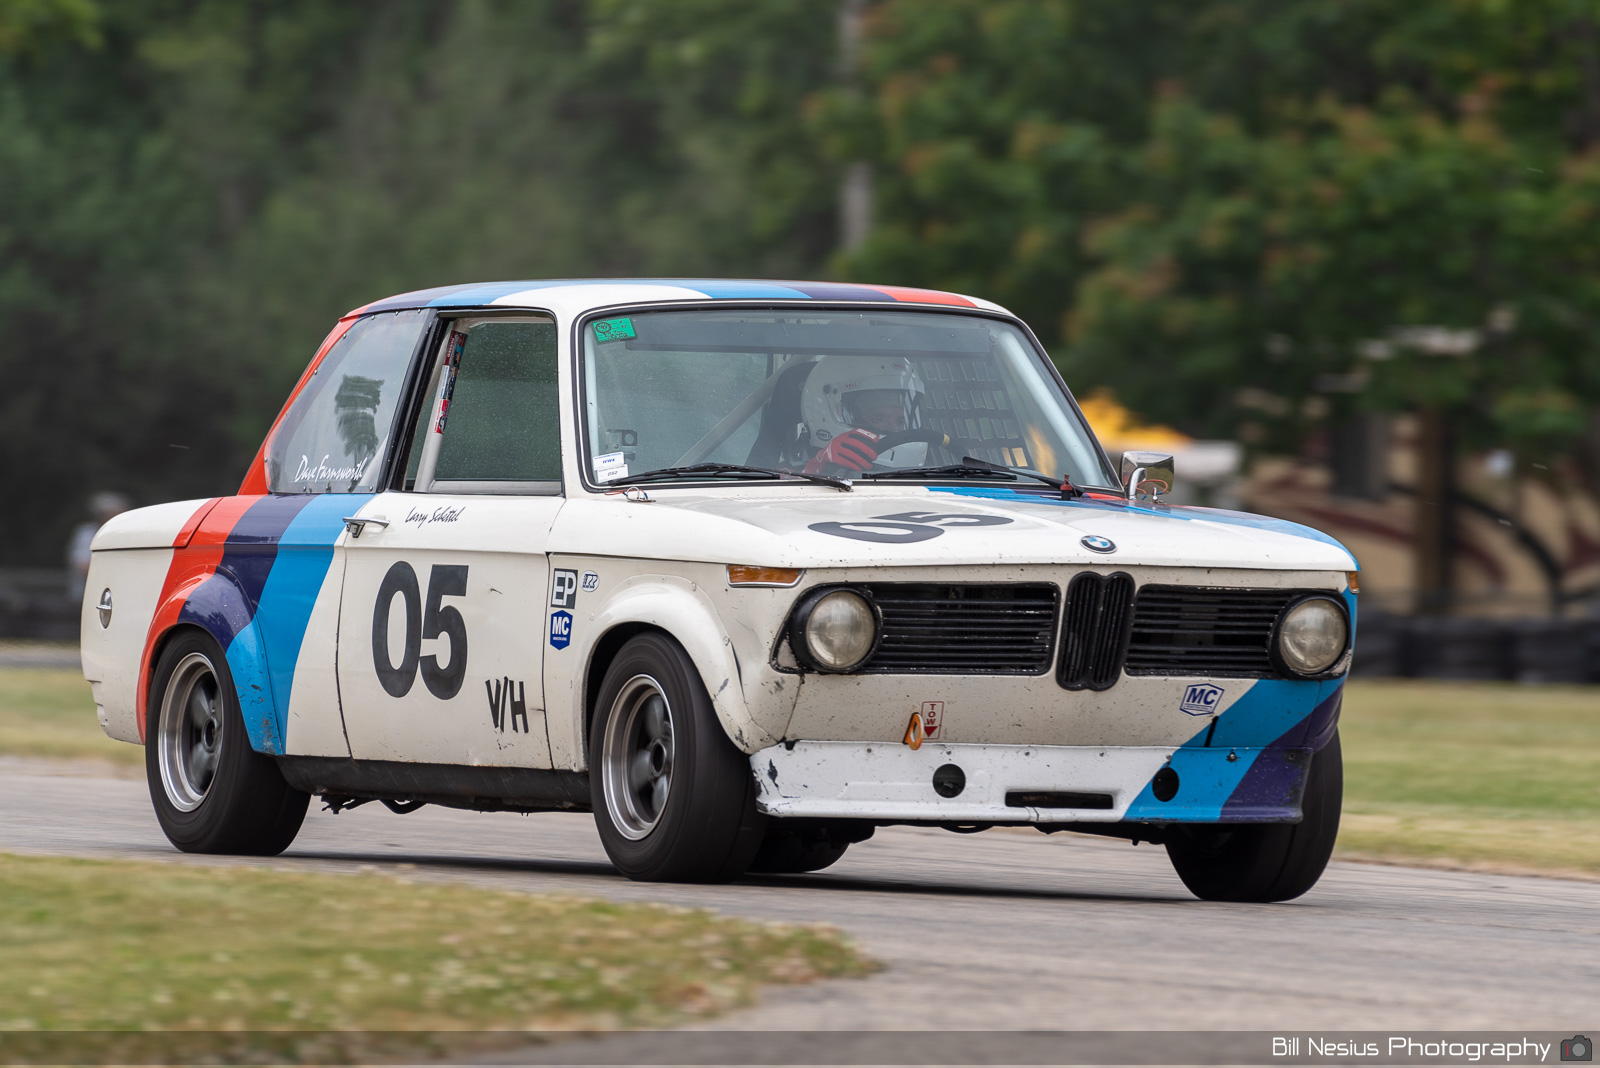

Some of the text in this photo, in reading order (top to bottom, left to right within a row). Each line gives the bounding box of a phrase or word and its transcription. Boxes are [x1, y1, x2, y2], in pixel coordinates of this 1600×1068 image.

[294, 454, 368, 483] Dave Farnsworth
[405, 506, 428, 529] Larry
[807, 511, 1014, 544] 05
[551, 570, 577, 606] EP
[372, 560, 469, 700] 05
[552, 616, 570, 635] MC
[485, 676, 529, 733] V/H
[1186, 688, 1218, 705] MC
[926, 703, 936, 725] TOW
